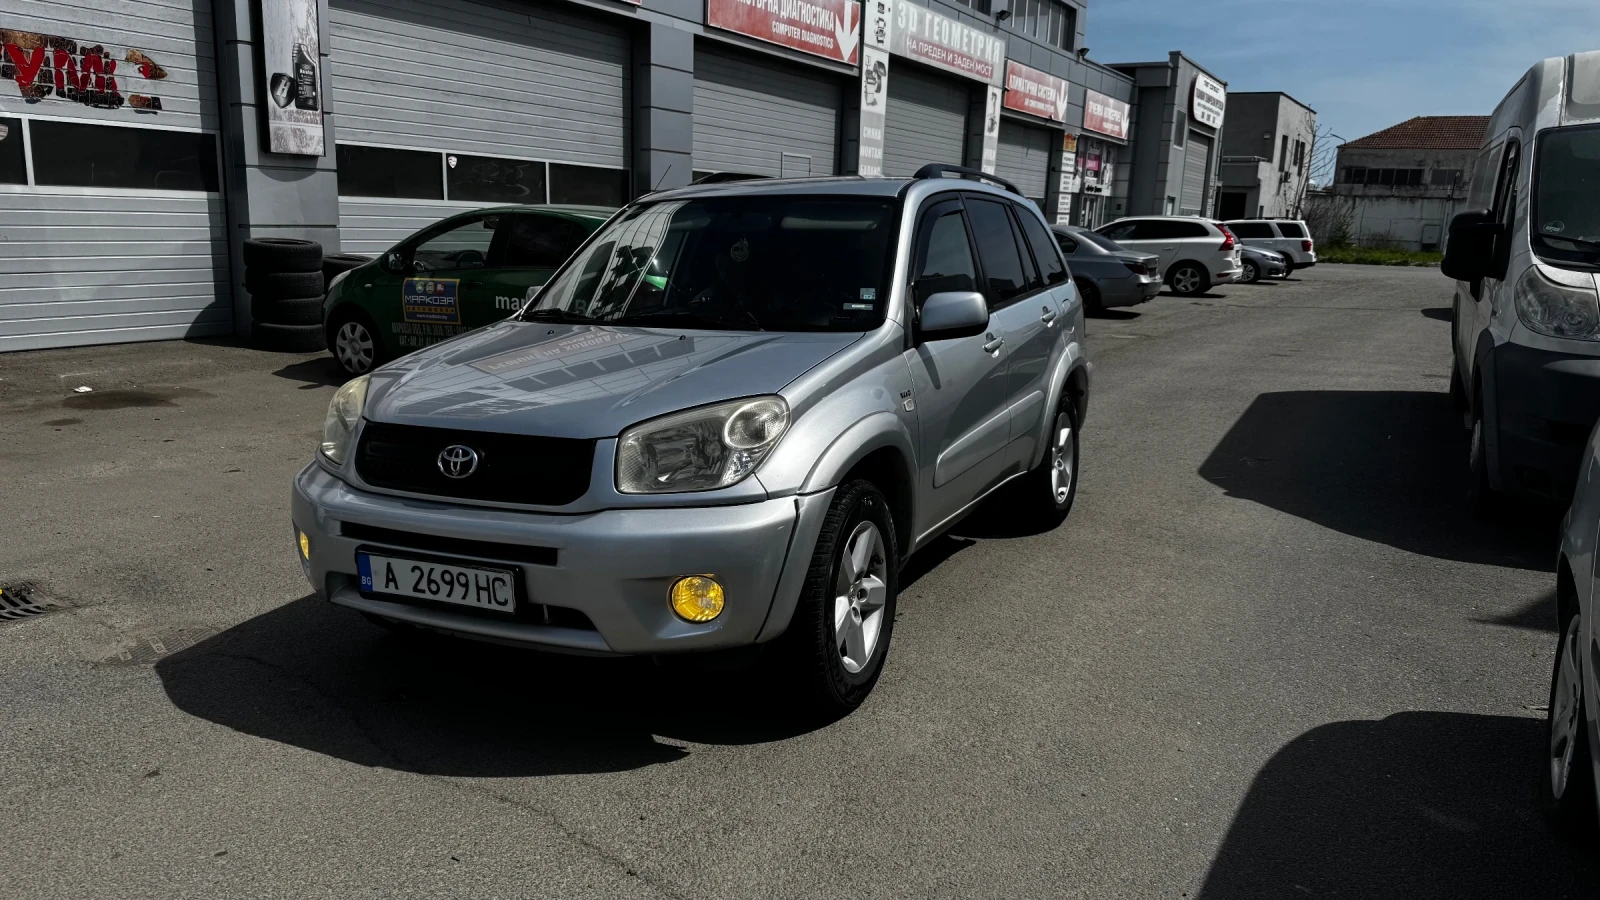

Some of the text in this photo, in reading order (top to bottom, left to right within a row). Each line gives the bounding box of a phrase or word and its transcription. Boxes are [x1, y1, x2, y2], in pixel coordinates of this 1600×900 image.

[772, 20, 834, 49] COMPUTER DIAGNOSTICS
[898, 2, 1001, 64] 3D ГЕОМЕТРИЯ
[906, 38, 992, 76] НА ПРЕДЕН И ЗАДЕН МОСТ
[361, 576, 372, 585] BG
[384, 561, 399, 590] A
